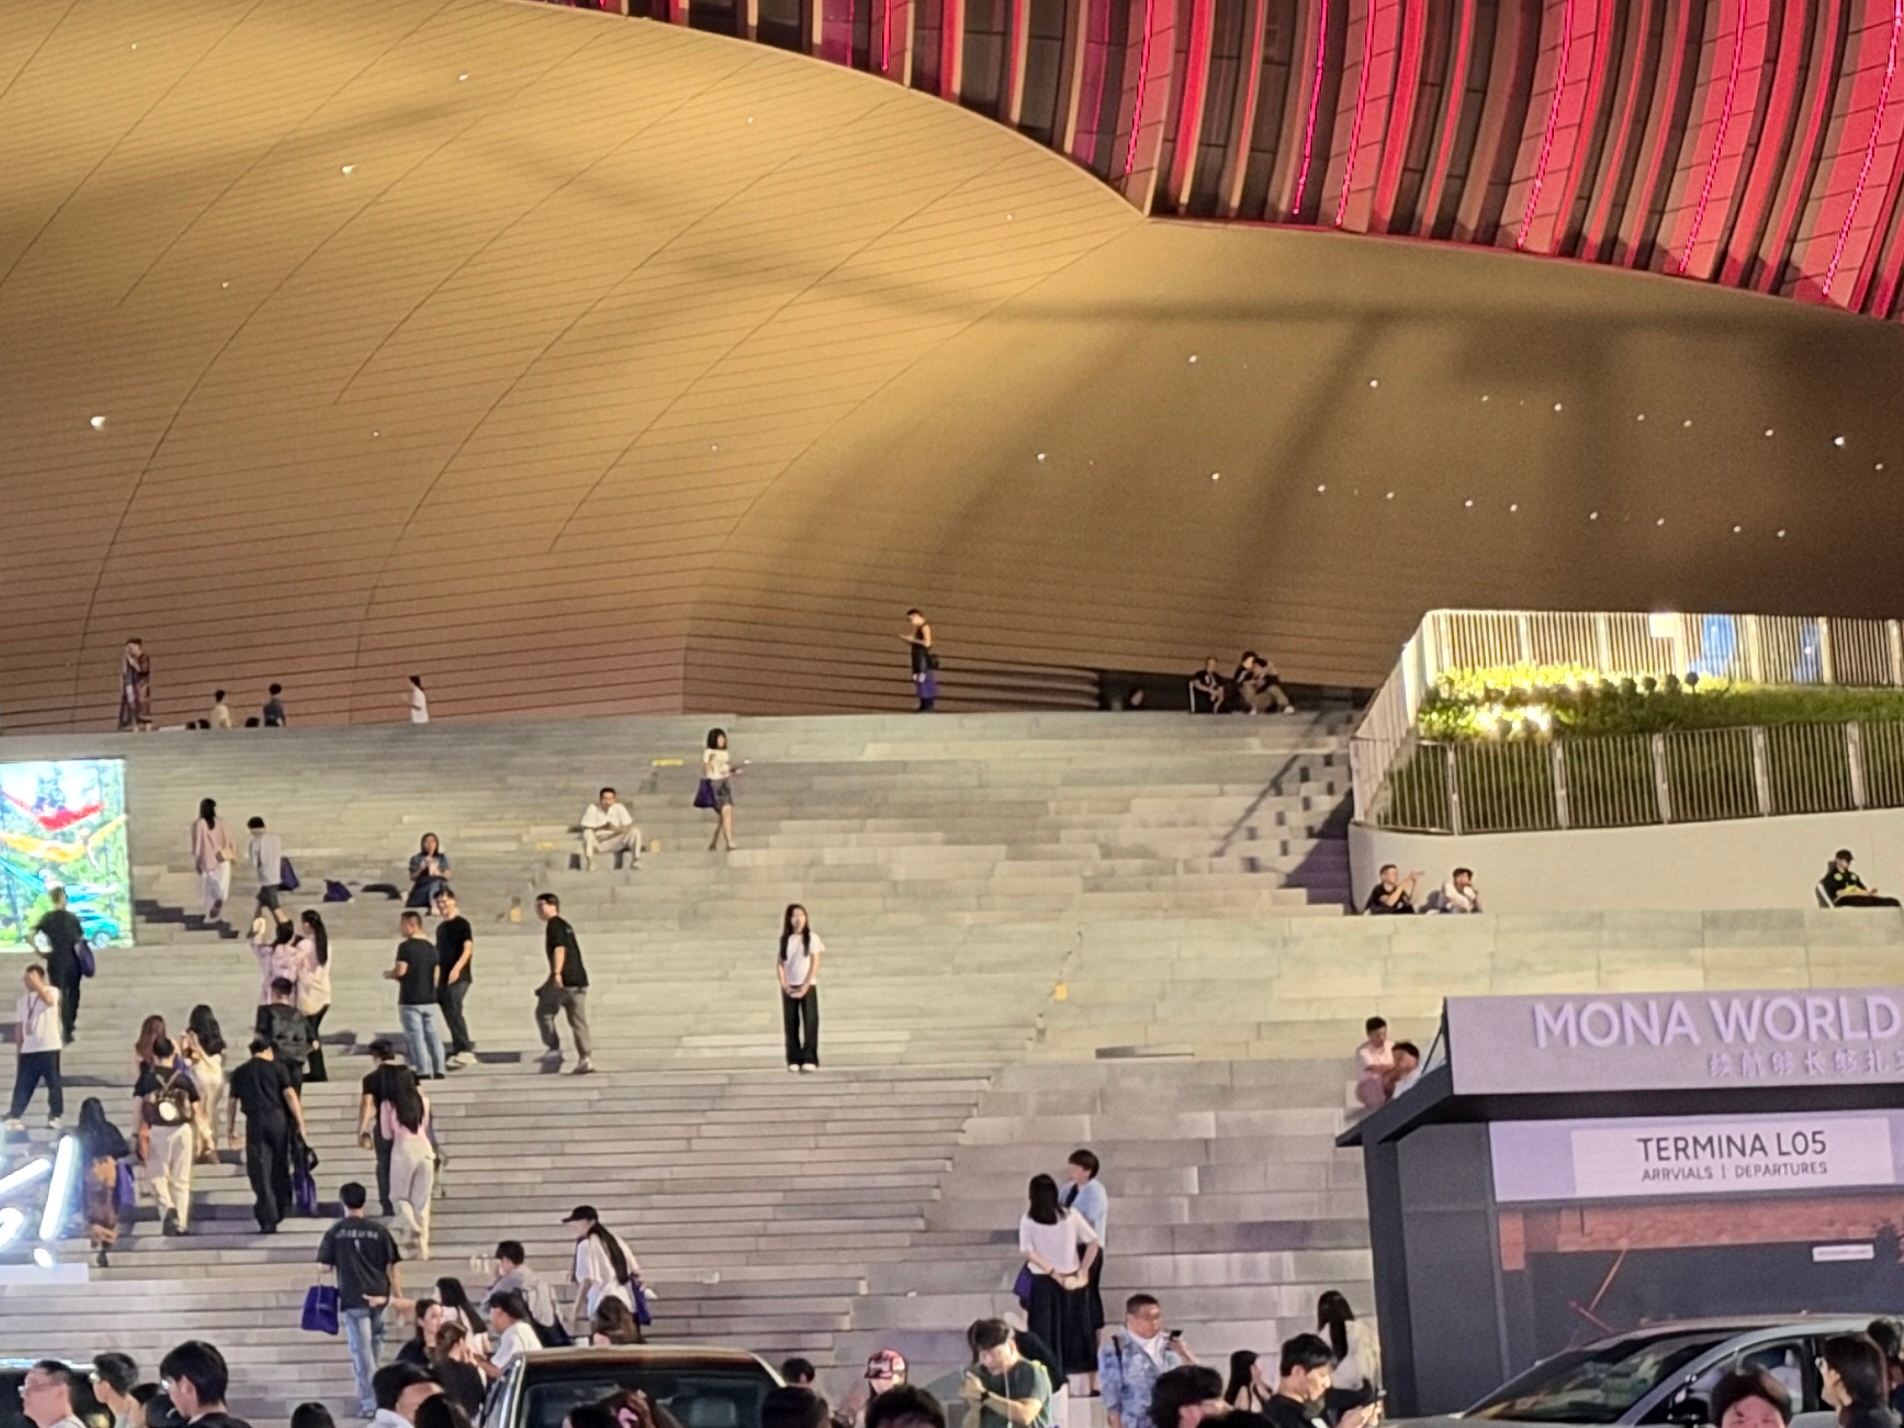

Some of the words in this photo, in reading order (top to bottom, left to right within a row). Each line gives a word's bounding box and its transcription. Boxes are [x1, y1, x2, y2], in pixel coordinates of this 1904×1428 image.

[1533, 999, 1701, 1049] MONA
[1708, 995, 1902, 1044] WORLD
[1638, 1134, 1769, 1162] TERMINA
[1734, 1161, 1829, 1178] DEPARTURES
